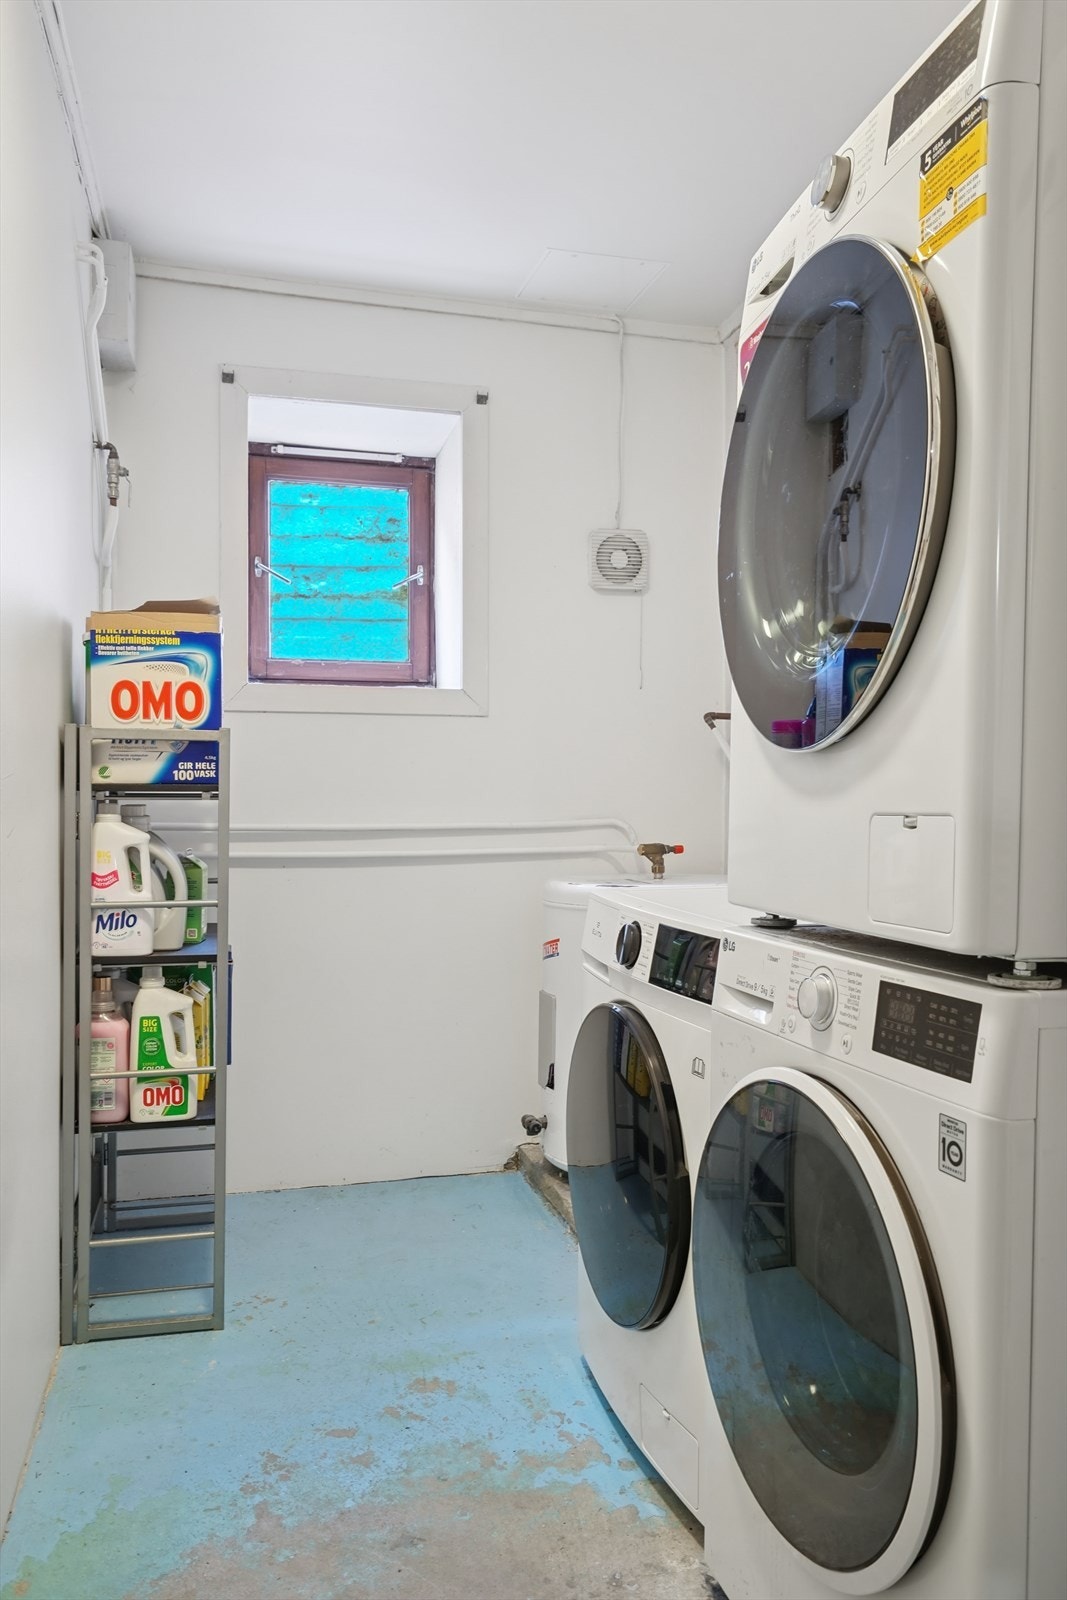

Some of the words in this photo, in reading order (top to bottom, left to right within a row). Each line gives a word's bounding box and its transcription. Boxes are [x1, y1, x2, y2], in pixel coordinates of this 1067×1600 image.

[960, 102, 982, 128] Whirlpool
[924, 150, 932, 172] 5
[95, 635, 181, 645] flekkfjerningssystem
[110, 679, 206, 721] OMO
[172, 770, 194, 781] 100
[194, 770, 217, 778] VASK
[178, 762, 194, 770] GIR
[195, 762, 217, 770] HELE
[95, 910, 138, 934] Milo
[143, 1019, 158, 1027] BIG
[142, 1086, 183, 1107] OMO
[941, 1121, 953, 1130] Direct
[953, 1126, 964, 1135] Drive
[941, 1136, 963, 1167] 10
